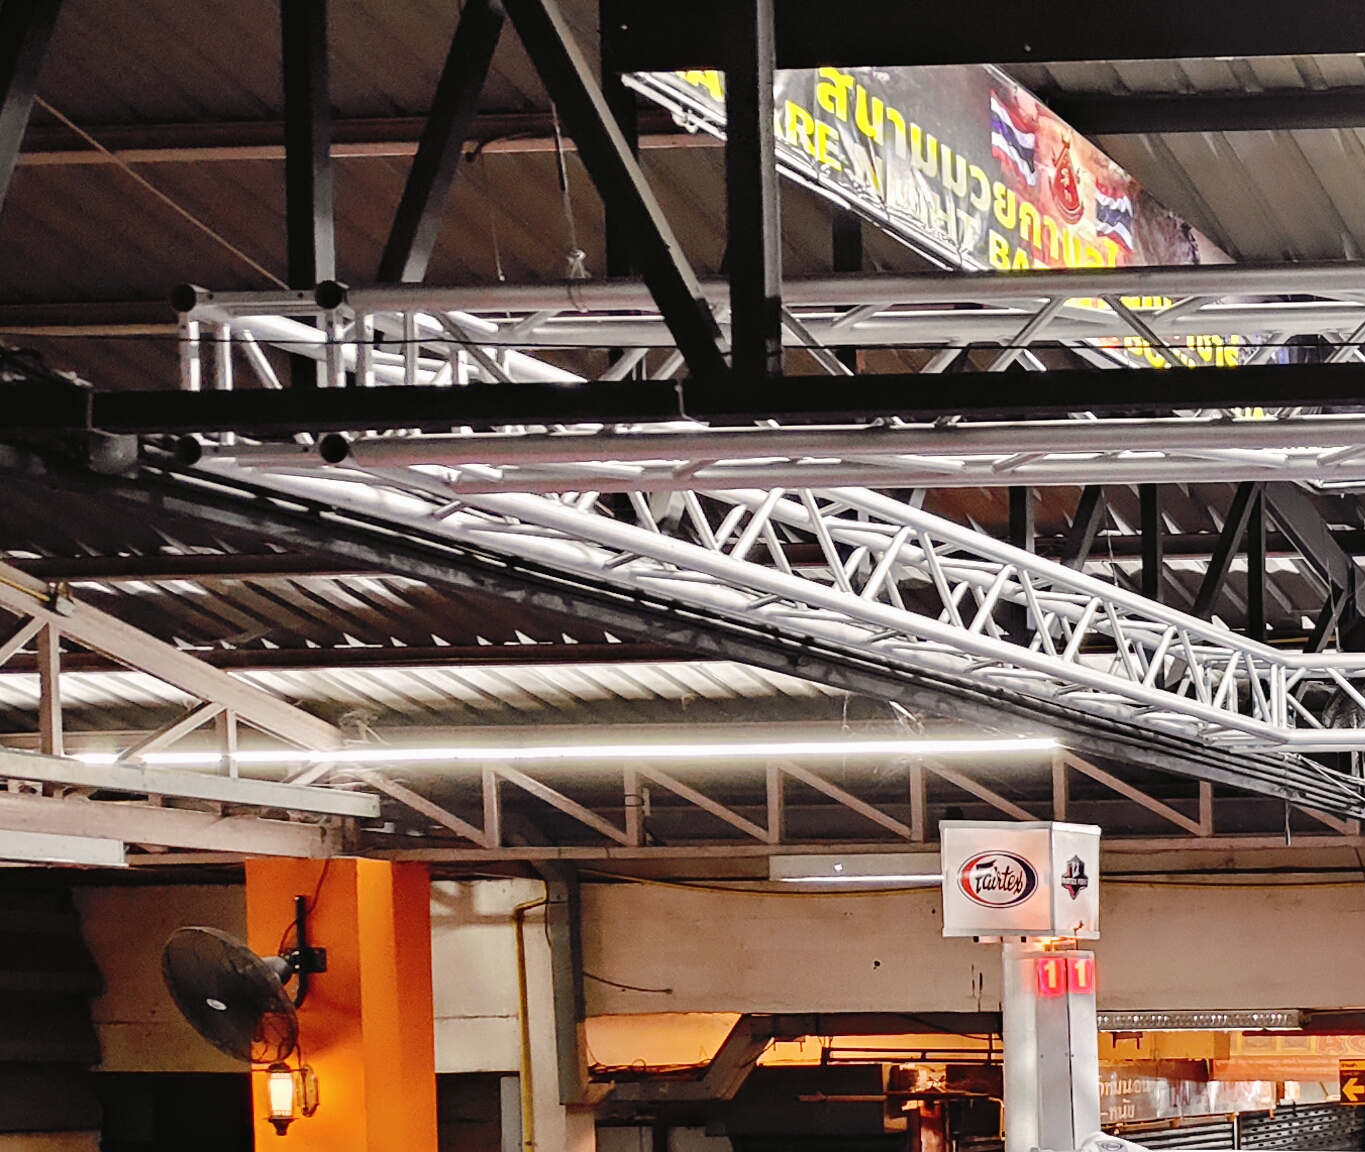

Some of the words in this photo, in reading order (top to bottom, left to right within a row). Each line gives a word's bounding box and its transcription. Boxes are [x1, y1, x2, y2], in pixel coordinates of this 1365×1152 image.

[975, 858, 1024, 895] Fairtex
[1044, 960, 1057, 989] 1
[1075, 959, 1087, 988] 1
